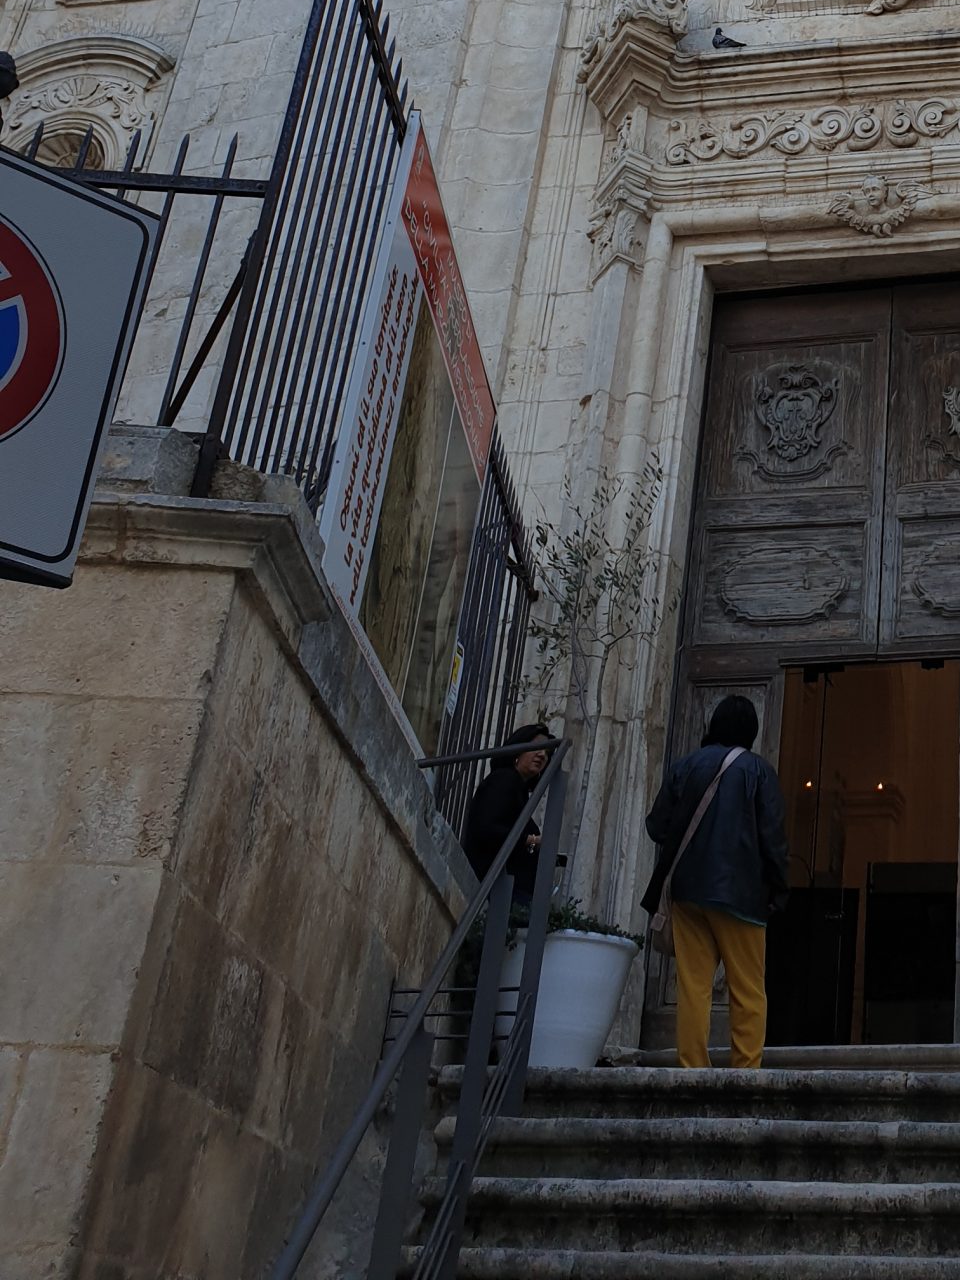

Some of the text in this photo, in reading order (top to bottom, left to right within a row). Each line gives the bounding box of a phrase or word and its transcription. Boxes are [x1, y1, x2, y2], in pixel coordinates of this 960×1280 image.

[406, 196, 428, 279] DELLA
[340, 445, 359, 531] Ostuni
[357, 416, 365, 450] ed
[361, 398, 369, 420] il
[368, 358, 378, 400] suo
[350, 550, 364, 606] nelle
[361, 396, 394, 548] testimonianze
[351, 494, 362, 538] vita
[362, 373, 387, 493] quotidiana
